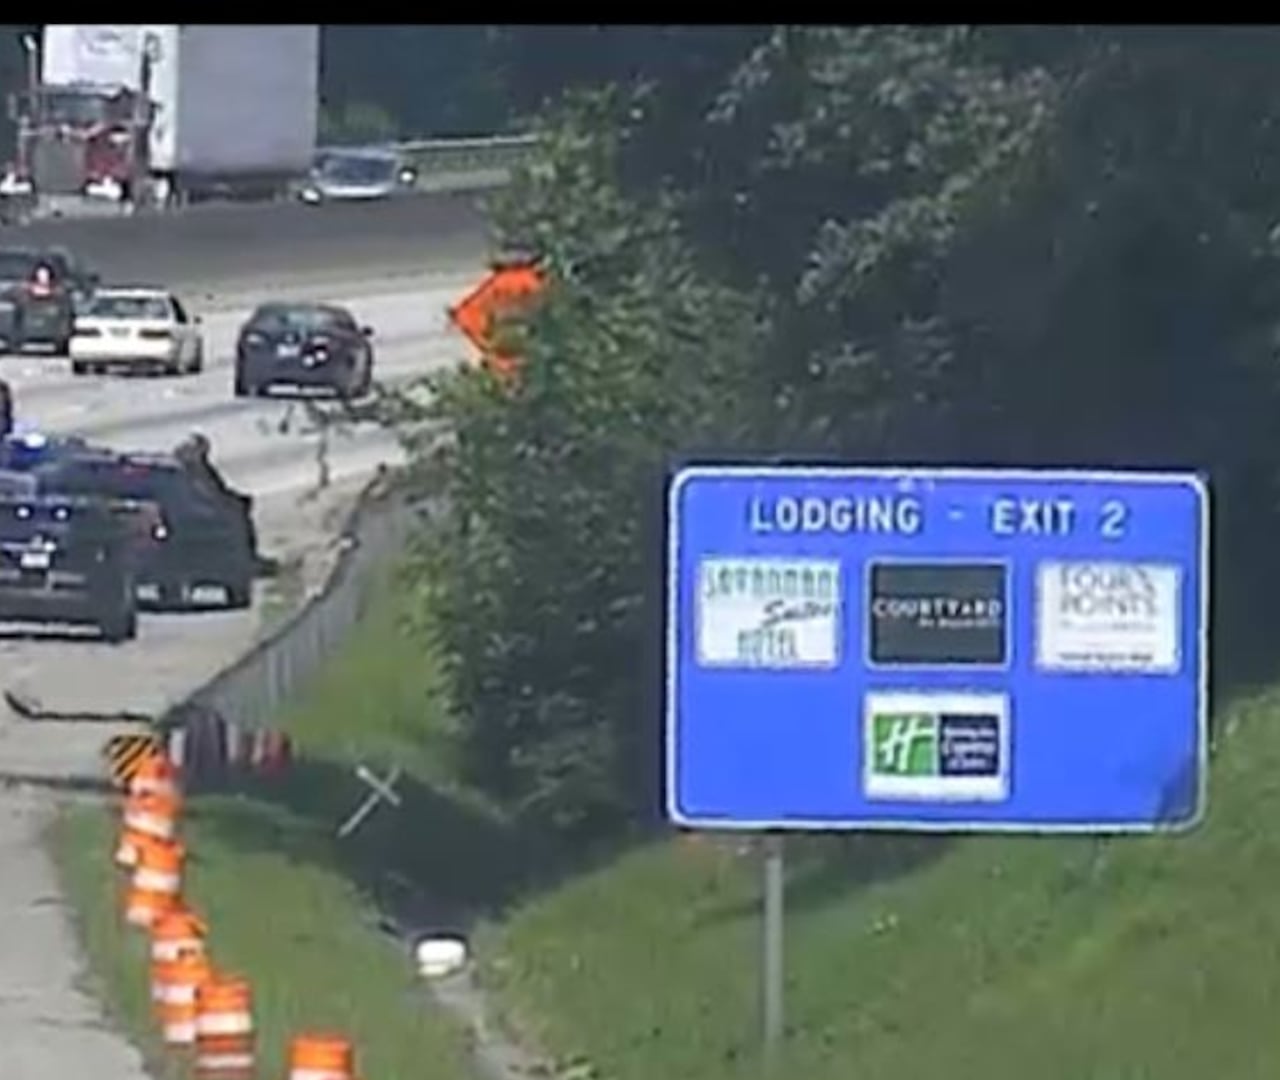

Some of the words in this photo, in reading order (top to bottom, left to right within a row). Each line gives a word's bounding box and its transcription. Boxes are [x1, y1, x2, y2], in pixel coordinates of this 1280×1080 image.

[750, 499, 921, 534] LODGING
[992, 501, 1075, 535] EXIT
[1099, 501, 1127, 539] 2
[873, 598, 1002, 618] COURTYARD
